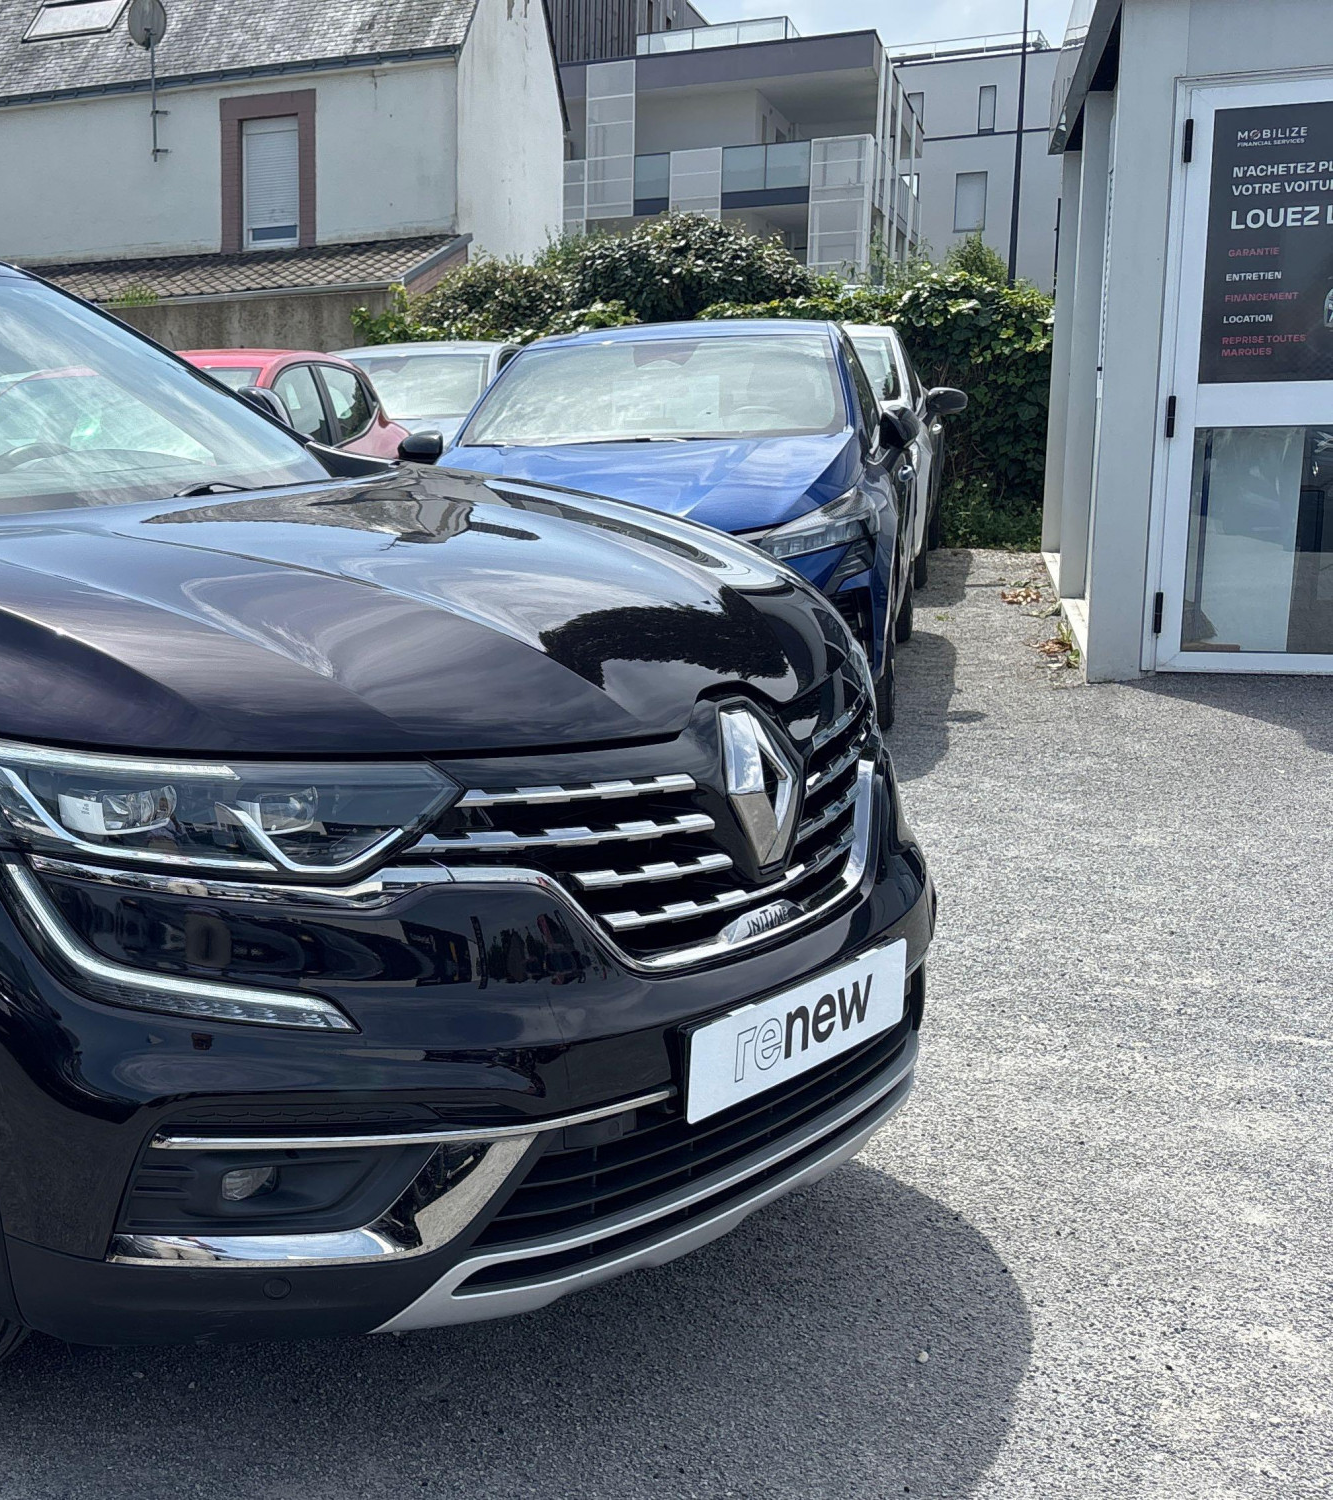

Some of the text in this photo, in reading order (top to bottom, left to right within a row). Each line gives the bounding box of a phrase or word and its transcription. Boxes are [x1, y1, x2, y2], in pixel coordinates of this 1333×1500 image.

[1237, 126, 1308, 140] MOBILIZE
[1236, 137, 1305, 148] FINANCIAL SERVICES
[1231, 182, 1281, 196] VOTRE
[1230, 205, 1320, 230] LOUEZ
[1228, 246, 1280, 257] GARANTIE
[1225, 271, 1282, 282] ENTRETIEN
[1224, 291, 1299, 303] FINANCEMENT
[1223, 314, 1273, 324] LOCATION
[1221, 334, 1307, 345] REPRISE TOUTES
[1221, 347, 1273, 357] MARQUES
[734, 973, 873, 1083] renew
